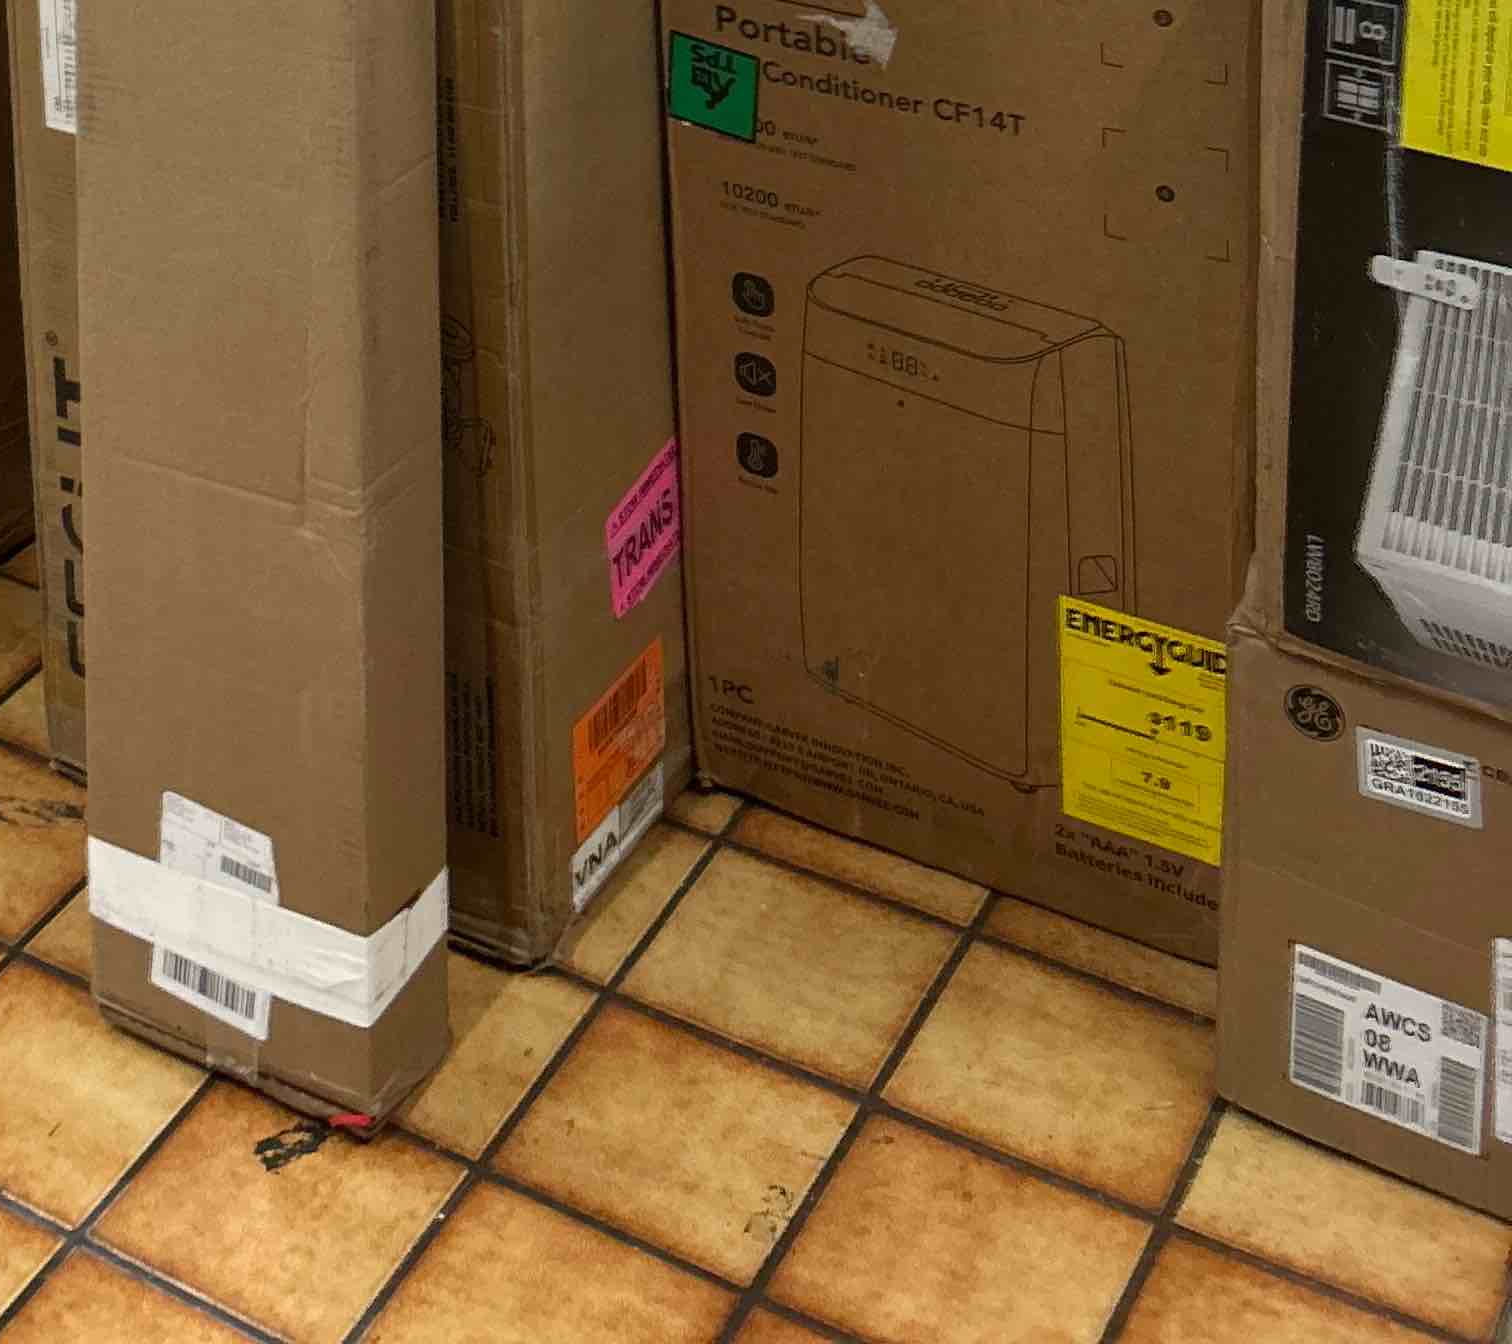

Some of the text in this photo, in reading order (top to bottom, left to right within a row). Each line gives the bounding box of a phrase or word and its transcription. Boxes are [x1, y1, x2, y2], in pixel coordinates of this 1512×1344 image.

[762, 61, 1026, 136] Conditioner CF14T
[721, 180, 778, 209] 10200
[1066, 608, 1226, 674] ENERGYGUID
[1055, 841, 1220, 912] Batteries include
[1364, 1028, 1392, 1053] 08
[1365, 1002, 1431, 1042] AWCS
[1363, 1048, 1420, 1089] WWA
